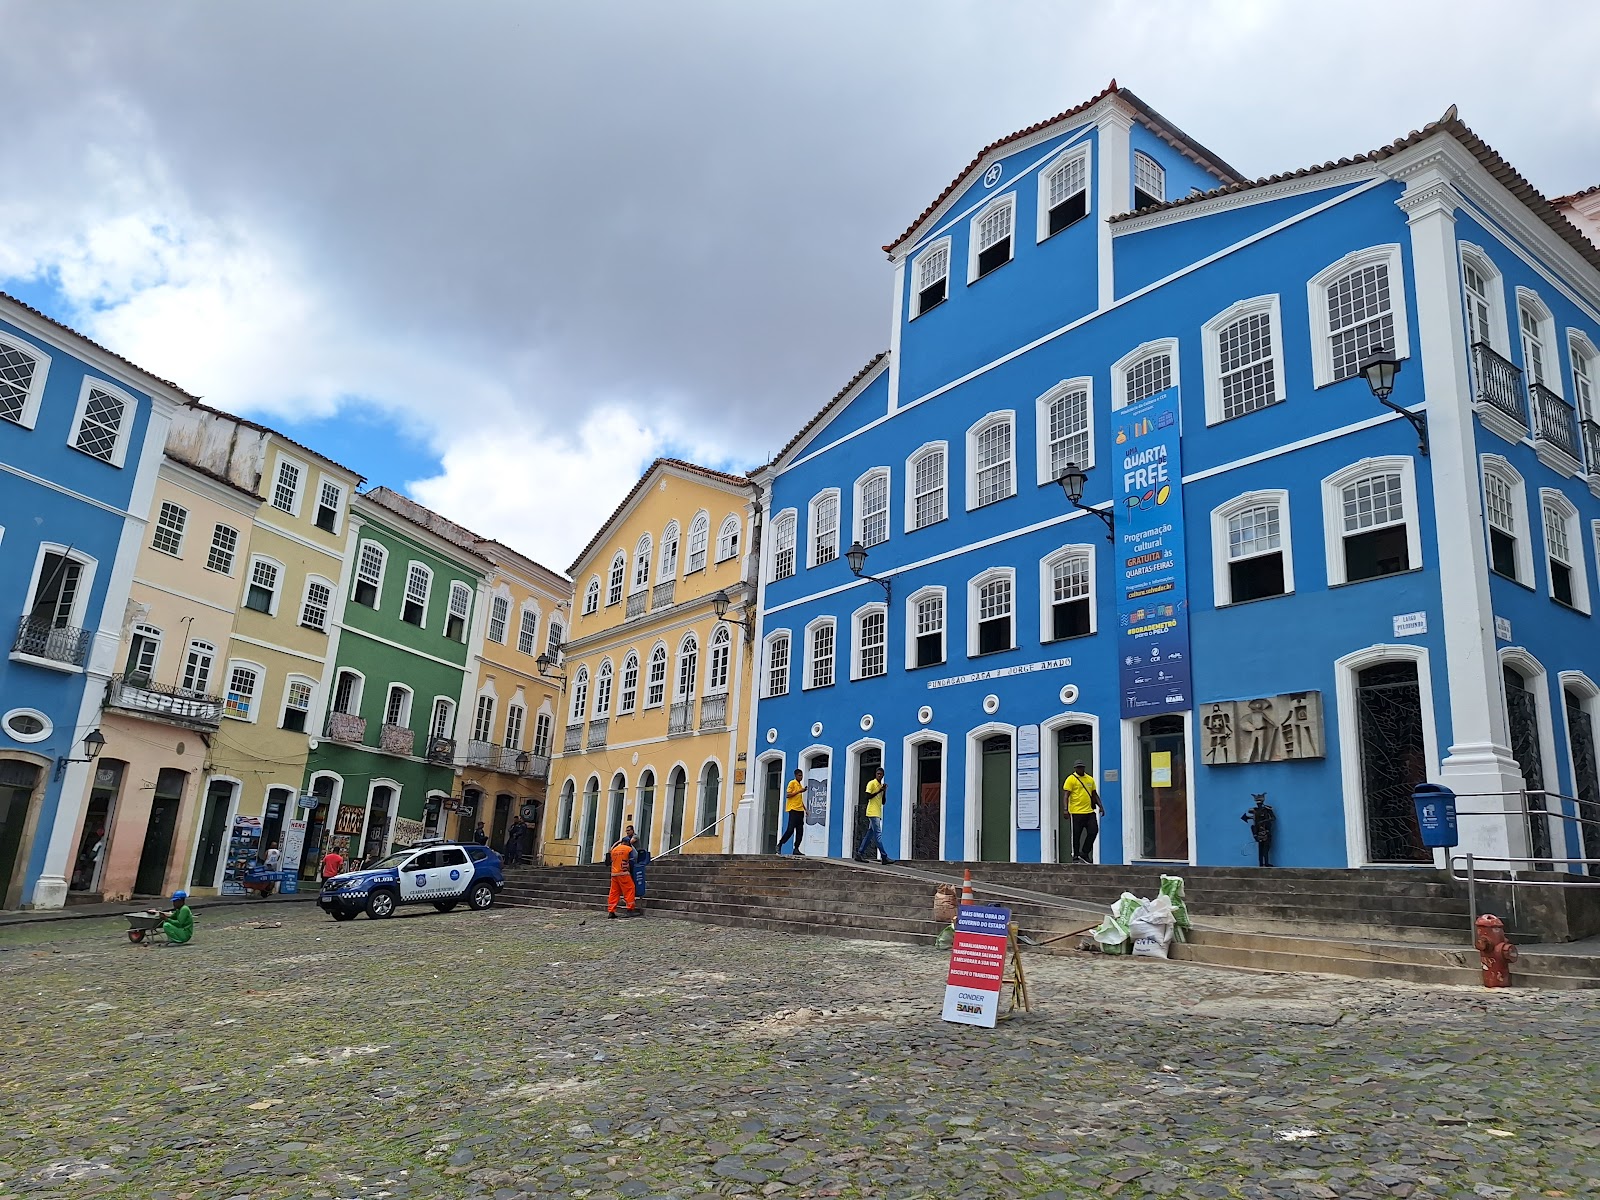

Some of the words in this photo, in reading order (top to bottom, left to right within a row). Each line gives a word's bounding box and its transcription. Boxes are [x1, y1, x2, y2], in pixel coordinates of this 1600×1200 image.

[1123, 444, 1168, 470] QUARTA
[1125, 446, 1138, 457] UMA
[1124, 461, 1168, 493] FREE
[1124, 524, 1172, 543] Programação
[1133, 537, 1163, 552] cultural
[1127, 551, 1160, 567] GRATUITA
[1163, 549, 1173, 558] às
[1125, 560, 1174, 578] QUARTAS-FEIRAS
[1007, 664, 1035, 675] JORGE
[1040, 658, 1071, 669] AMADO
[958, 919, 980, 927] GOVERNO
[987, 922, 1006, 930] ESTADO
[958, 942, 987, 950] TRABALHANDO
[953, 949, 981, 957] TRANSFORMAR
[981, 952, 1003, 960] SALVADOR
[972, 972, 1000, 980] TRANSTORNO
[958, 992, 985, 1002] CONDER
